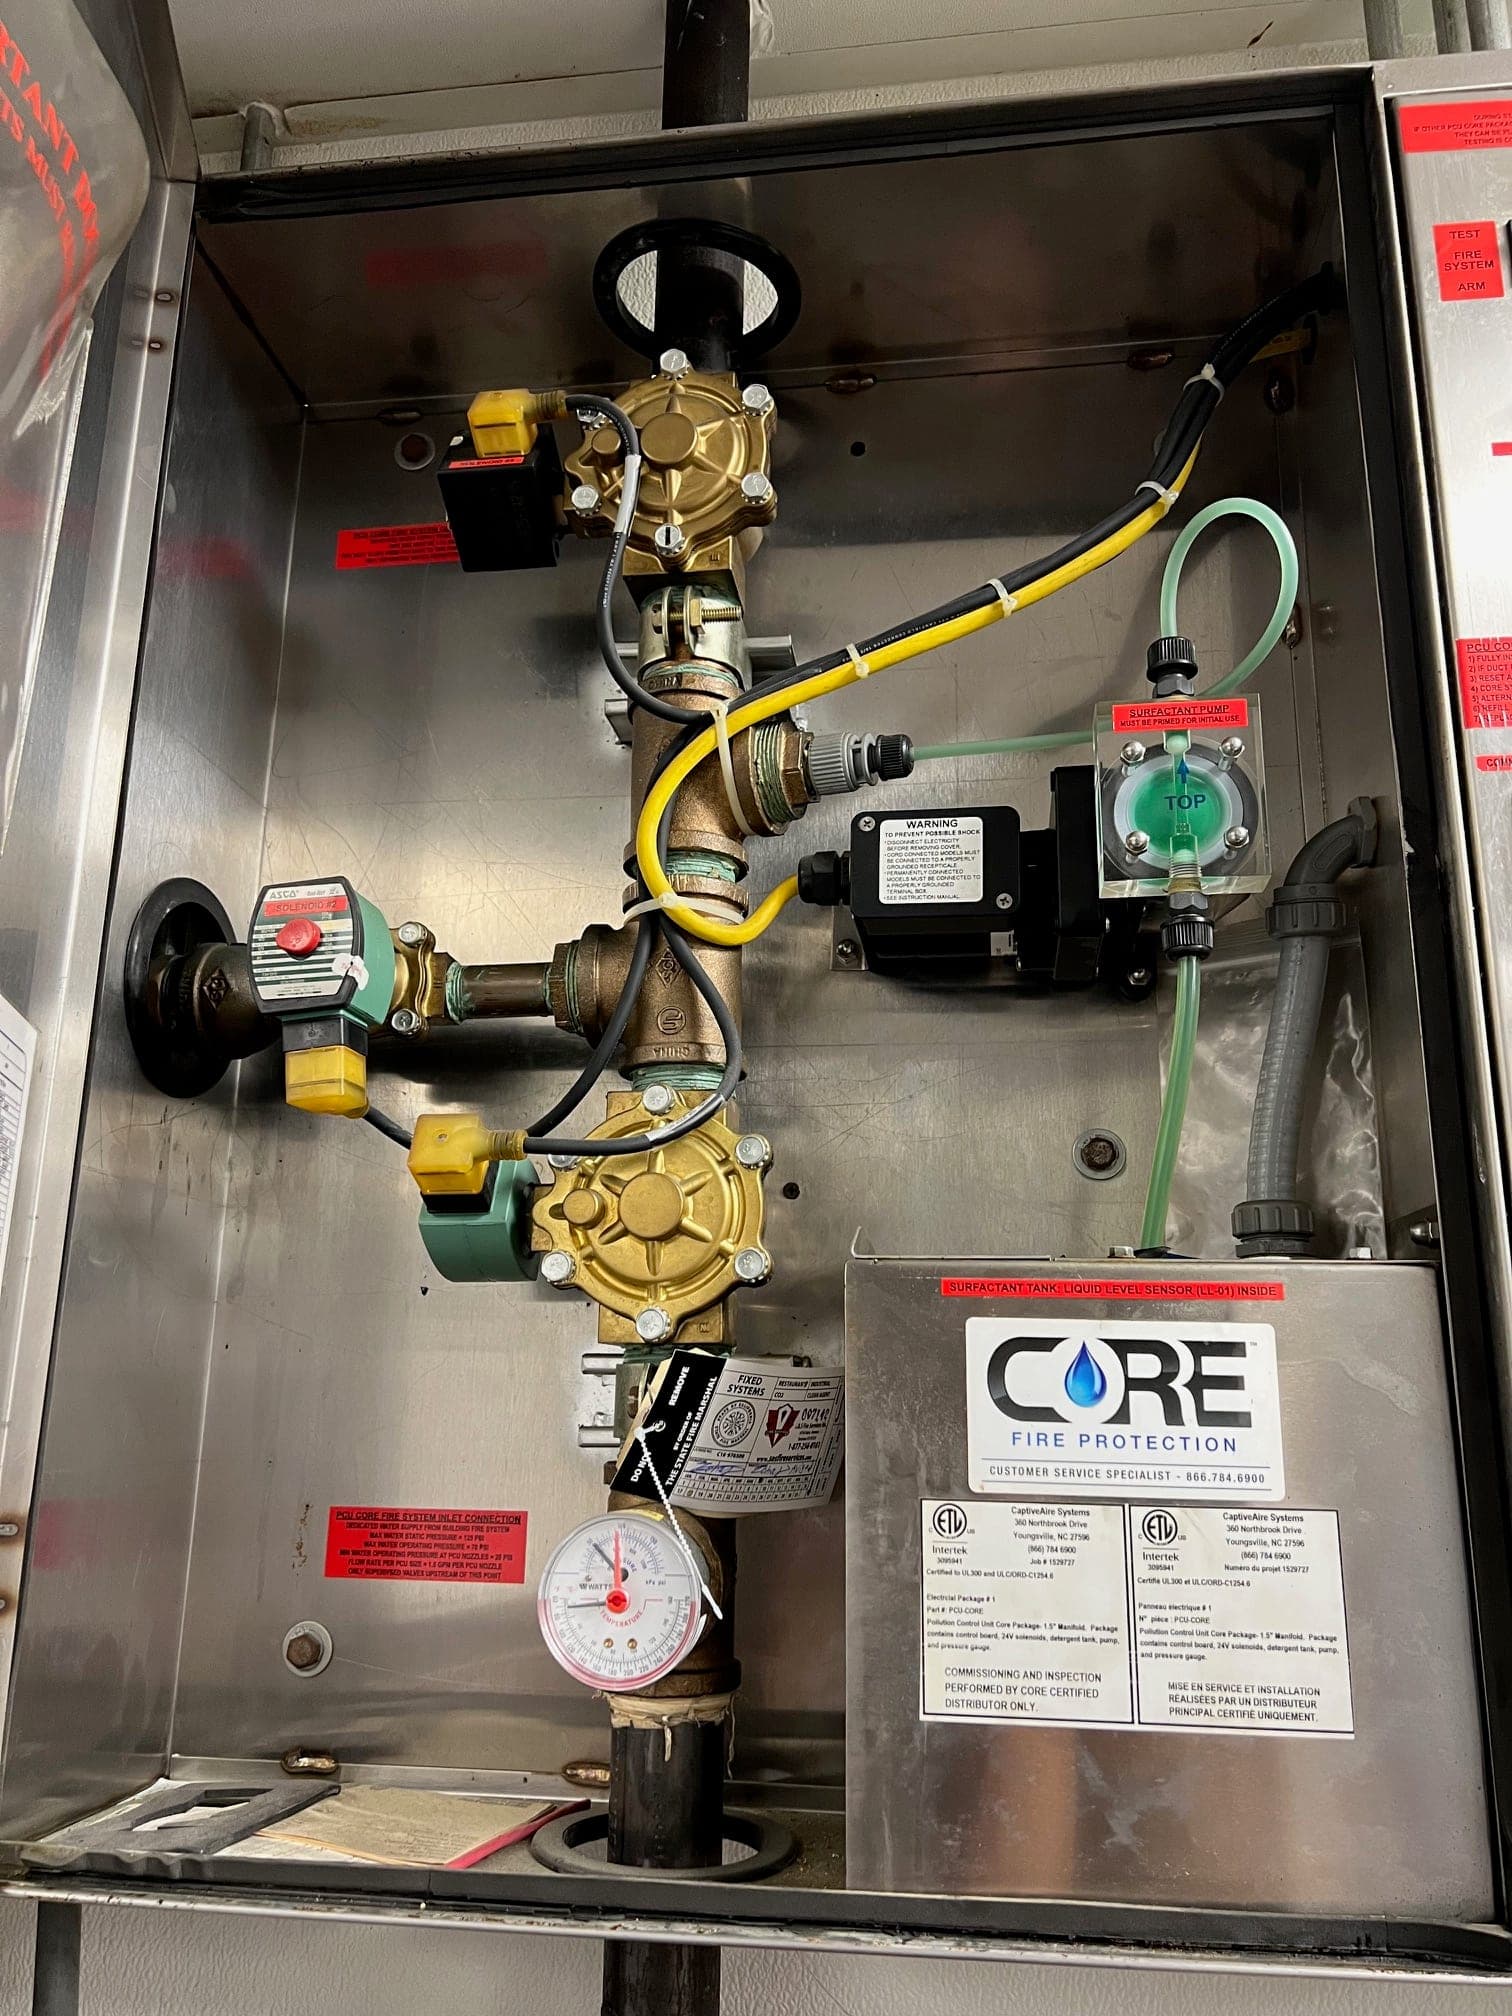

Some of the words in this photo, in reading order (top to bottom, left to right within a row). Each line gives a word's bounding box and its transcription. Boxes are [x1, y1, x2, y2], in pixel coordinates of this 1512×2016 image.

[1449, 230, 1480, 239] TEST
[1454, 250, 1482, 260] FIRE
[1445, 260, 1494, 271] SYSTEM
[1458, 282, 1485, 291] ARM
[1467, 643, 1490, 652] PCU
[1130, 706, 1197, 717] SURFACTANT
[1201, 705, 1229, 714] PUMP
[1165, 794, 1206, 810] TOP
[907, 819, 958, 828] WARNING
[276, 903, 325, 912] SOLENOID
[949, 1282, 1024, 1293] SURFACTANT
[1064, 1284, 1102, 1295] LIQUID
[1106, 1285, 1143, 1295] LEVEL
[1145, 1285, 1193, 1296] SENSOR
[1197, 1285, 1234, 1298] (LL-01)
[1238, 1286, 1276, 1297] INSIDE
[738, 1375, 762, 1386] FIXED
[727, 1384, 765, 1396] SYSTEMS
[631, 1469, 641, 1482] DO
[668, 1366, 690, 1406] REMOVE
[665, 1469, 679, 1486] THE
[674, 1442, 692, 1469] STATE
[686, 1421, 699, 1442] FIRE
[695, 1376, 718, 1421] MARSHAL
[1012, 1431, 1064, 1448] FIRE
[1080, 1433, 1237, 1453] PROTECTION
[990, 1466, 1049, 1477] CUSTOMER
[1054, 1468, 1100, 1479] SERVICE
[1106, 1469, 1170, 1481] SPECIALIST
[1186, 1472, 1264, 1484] 866.784.6900
[356, 1512, 379, 1521] CORE
[382, 1513, 400, 1521] FIRE
[403, 1514, 435, 1522] SYSTEM
[439, 1514, 462, 1523] INLET
[465, 1515, 520, 1524] CONNECTION
[1011, 1507, 1055, 1517] CaptiveAire
[1058, 1508, 1090, 1519] Systems
[1223, 1512, 1268, 1523] CaptiveAire
[1271, 1513, 1303, 1523] Systems
[1029, 1520, 1066, 1528] Northbrook
[1069, 1520, 1087, 1528] Drive
[1241, 1525, 1281, 1534] Northbrook
[1283, 1526, 1301, 1534] Drive
[1013, 1532, 1055, 1542] Youngsville,
[1226, 1538, 1269, 1548] Youngsville,
[1271, 1539, 1281, 1547] NC
[1284, 1539, 1304, 1547] 27596
[932, 1545, 967, 1555] Intertek
[1060, 1546, 1076, 1554] 6900
[1143, 1552, 1179, 1561] Intertek
[599, 1609, 643, 1627] TEMPERATURE
[945, 1667, 1020, 1679] COMMISSIONING
[1023, 1671, 1042, 1680] AND
[1045, 1671, 1101, 1682] INSPECTION
[945, 1683, 1003, 1694] PERFORMED
[1006, 1685, 1018, 1695] BY
[1021, 1686, 1047, 1696] CORE
[1050, 1687, 1099, 1698] CERTIFIED
[1168, 1682, 1188, 1691] MISE
[1191, 1683, 1203, 1691] EN
[1205, 1683, 1242, 1693] SERVICE
[1245, 1685, 1254, 1693] ET
[1258, 1685, 1320, 1696] INSTALLATION
[945, 1698, 1007, 1710] DISTRIBUTOR
[1010, 1701, 1038, 1712] ONLY.
[1219, 1696, 1236, 1705] PAR
[1239, 1697, 1250, 1705] UN
[1253, 1697, 1317, 1709] DISTRIBUTEUR
[1169, 1706, 1215, 1718] PRINCIPAL
